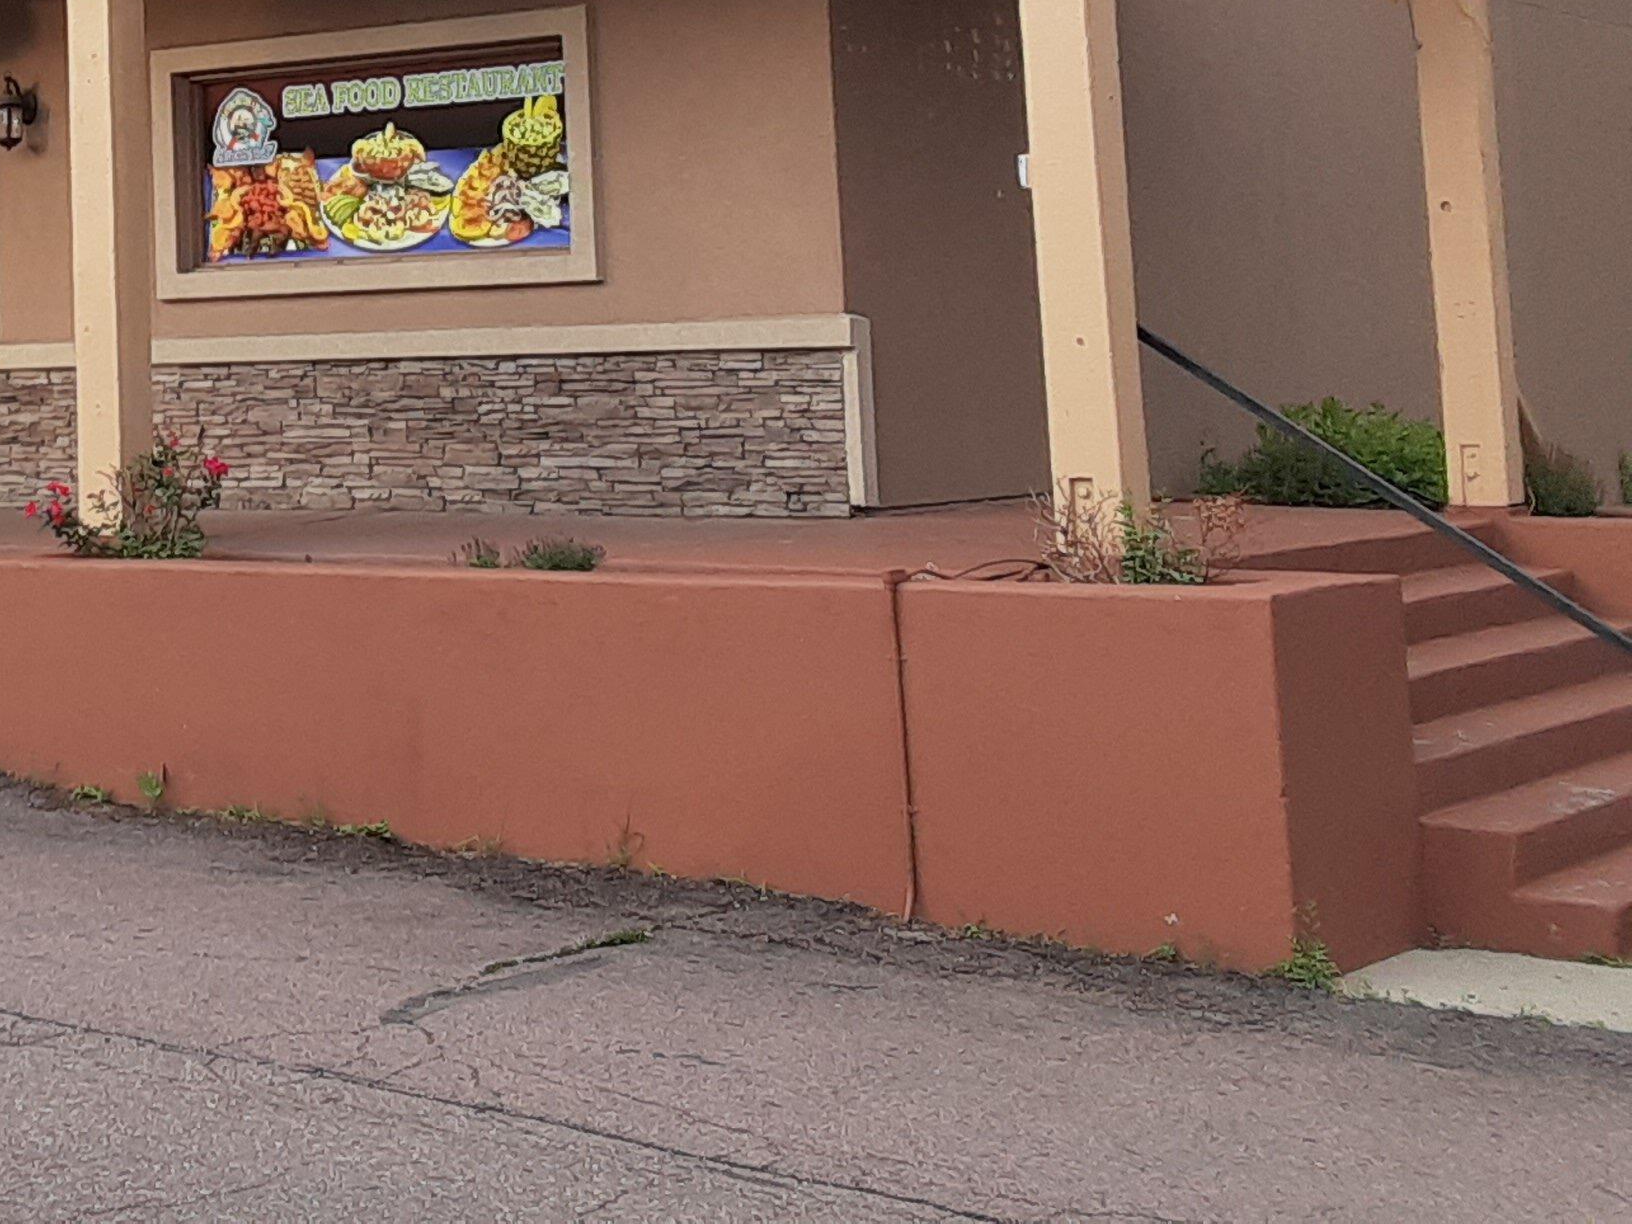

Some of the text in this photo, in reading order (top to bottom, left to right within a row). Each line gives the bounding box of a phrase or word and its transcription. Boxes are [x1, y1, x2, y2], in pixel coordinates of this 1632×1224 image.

[284, 85, 329, 116] SEA
[333, 80, 401, 112] FOOD
[405, 62, 565, 106] RESTAURANT
